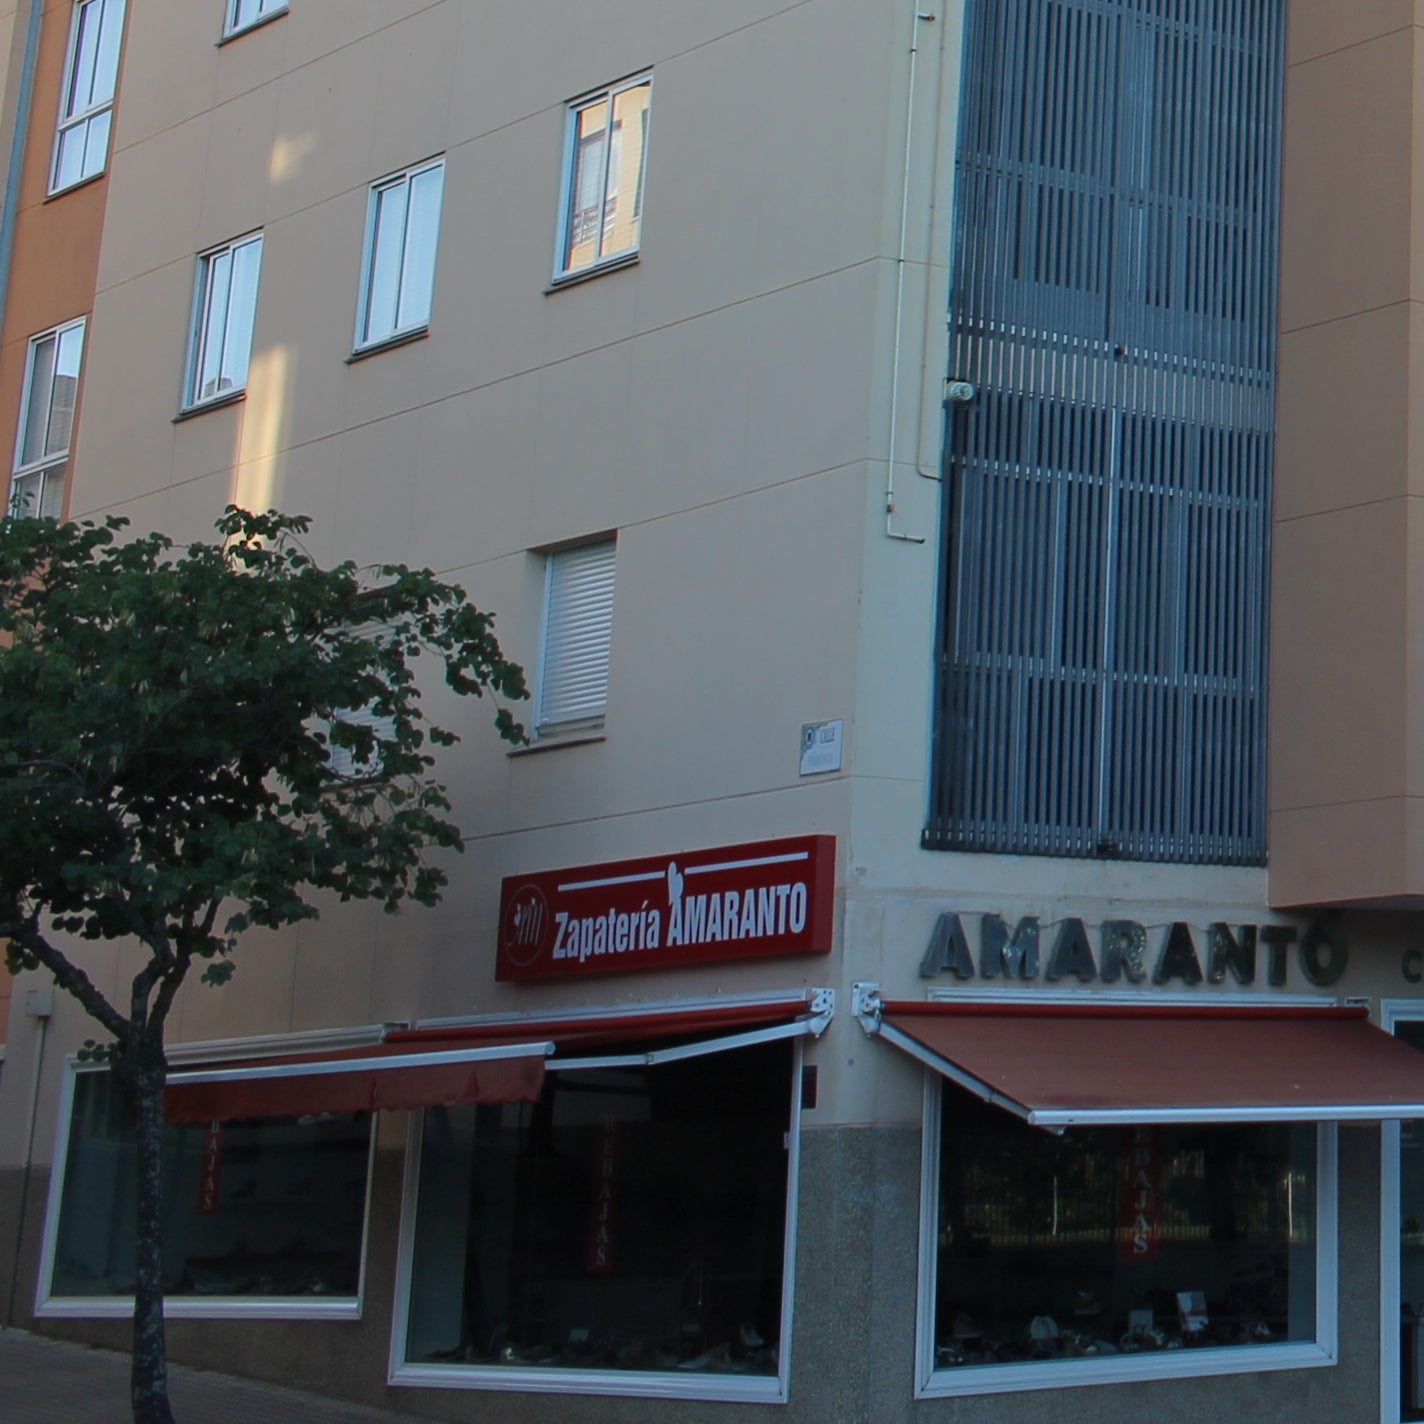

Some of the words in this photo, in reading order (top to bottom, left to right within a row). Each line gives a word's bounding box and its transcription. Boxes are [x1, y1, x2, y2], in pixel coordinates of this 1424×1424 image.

[551, 899, 661, 963] Zapatería
[666, 880, 808, 947] AMARANTO
[920, 910, 1349, 988] AMARANTO
